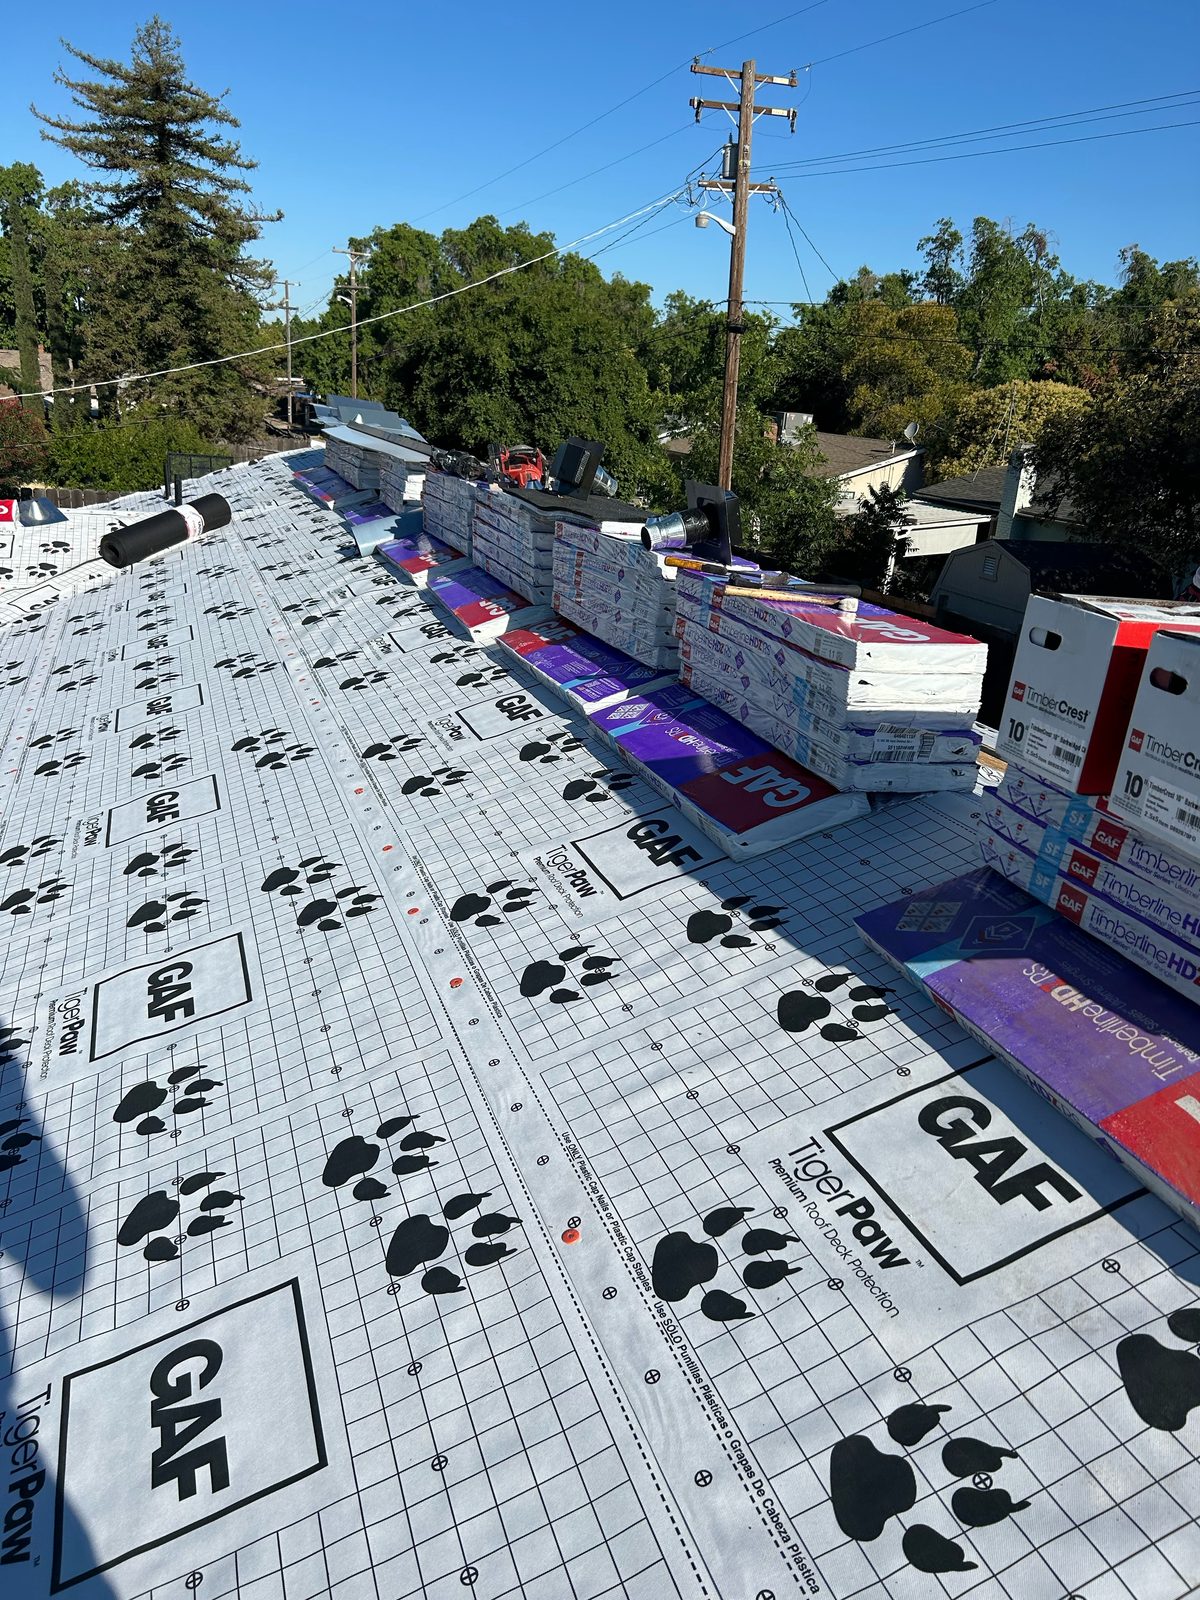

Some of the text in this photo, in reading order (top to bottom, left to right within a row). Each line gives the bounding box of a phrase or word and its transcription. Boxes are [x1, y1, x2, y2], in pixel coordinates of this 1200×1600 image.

[30, 594, 59, 610] GA
[419, 621, 454, 639] GAF
[854, 617, 930, 641] GA
[146, 695, 172, 715] GAF
[495, 694, 544, 722] GAF
[1027, 685, 1090, 722] TimberCrest
[1009, 718, 1025, 742] 10
[1146, 734, 1200, 770] TimberCr
[720, 765, 812, 807] GAF
[1124, 770, 1143, 798] 10
[146, 791, 180, 823] GAF
[626, 819, 703, 867] GAF
[1095, 830, 1122, 850] GAF
[546, 844, 598, 898] TigerPaw
[1035, 874, 1050, 887] SF
[1070, 862, 1096, 880] GAF
[1059, 894, 1084, 913] GAF
[147, 961, 195, 1022] GAF
[58, 987, 88, 1056] TigerPaw
[561, 1131, 572, 1144] Use
[566, 1143, 579, 1162] ONLY
[918, 1095, 1083, 1213] GAF
[577, 1159, 593, 1182] Plastic
[588, 1180, 600, 1195] Cap
[597, 1194, 610, 1213] Nails
[605, 1211, 615, 1222] or
[788, 1135, 912, 1270] TigerPaw
[610, 1220, 628, 1246] Plastic
[768, 1158, 900, 1319] Premium Roof Deck Protection
[624, 1245, 636, 1263] Cap
[632, 1262, 653, 1292] Staples
[653, 1301, 668, 1319] Use
[661, 1317, 683, 1345] SÓLO
[679, 1343, 703, 1385] Puntillas
[150, 1338, 231, 1502] GAF
[699, 1382, 729, 1431] Plásticas
[729, 1438, 756, 1479] Grapas
[0, 1383, 52, 1565] TigerPaw
[751, 1478, 765, 1497] De
[762, 1497, 791, 1543] Cabeza
[786, 1542, 820, 1595] Plástica
